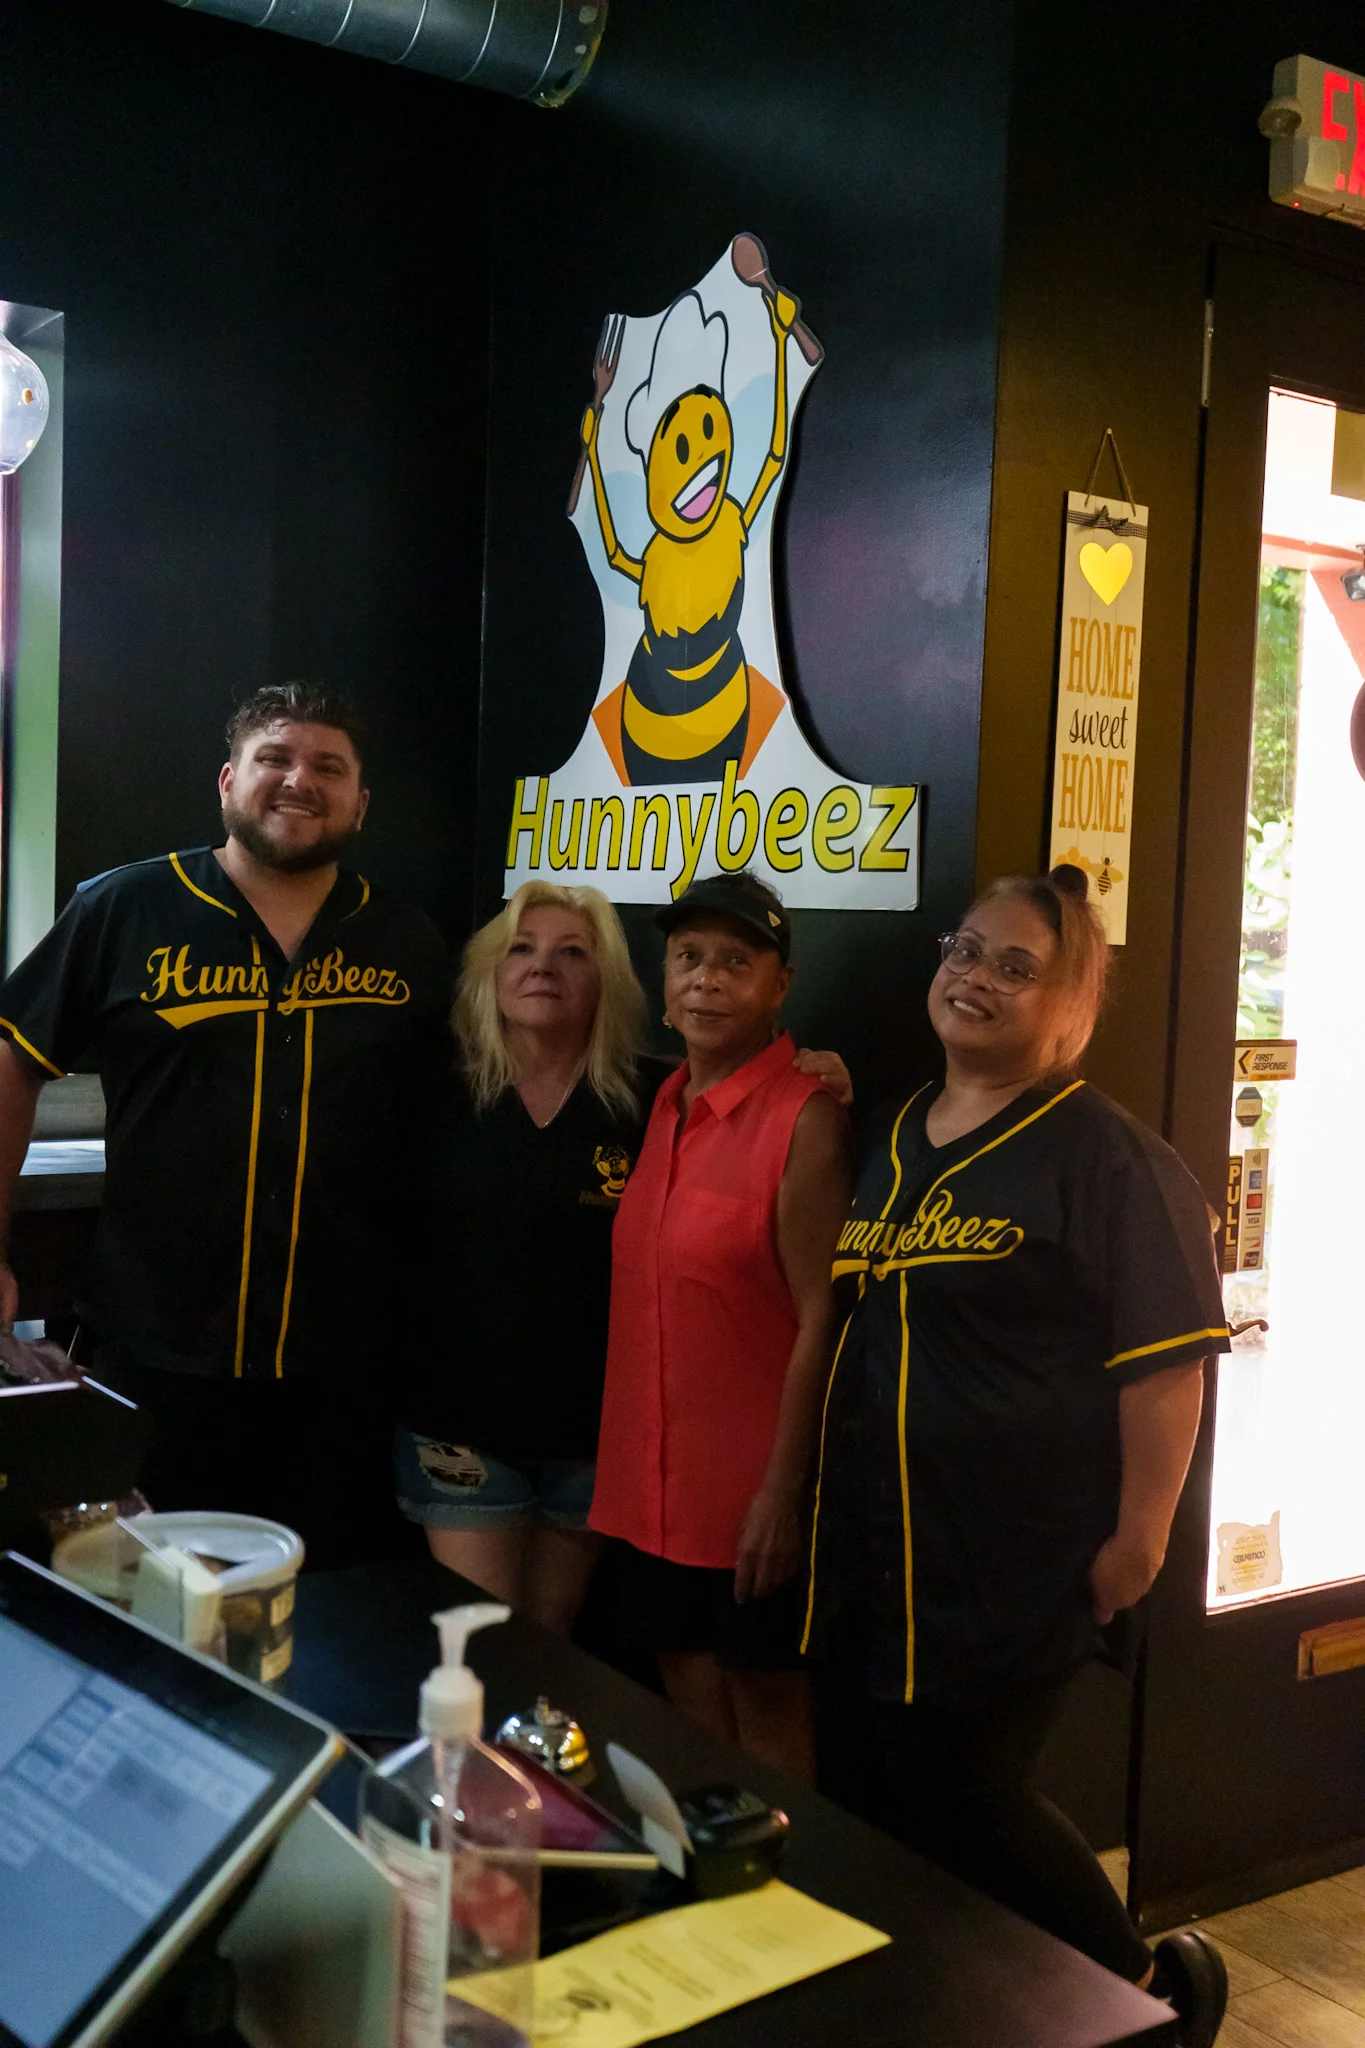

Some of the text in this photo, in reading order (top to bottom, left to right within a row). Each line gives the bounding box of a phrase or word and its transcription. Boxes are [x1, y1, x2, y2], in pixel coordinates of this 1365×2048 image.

[1066, 616, 1137, 700] HOME
[1069, 706, 1128, 750] sweet
[505, 758, 918, 903] Hunnybeez
[1058, 753, 1129, 833] HOME
[1252, 1062, 1288, 1071] RESPONSE
[1254, 1053, 1274, 1062] FIRST
[836, 1189, 1025, 1281] unnyBeez
[1225, 1165, 1241, 1245] PULL
[1247, 1217, 1260, 1225] VISA
